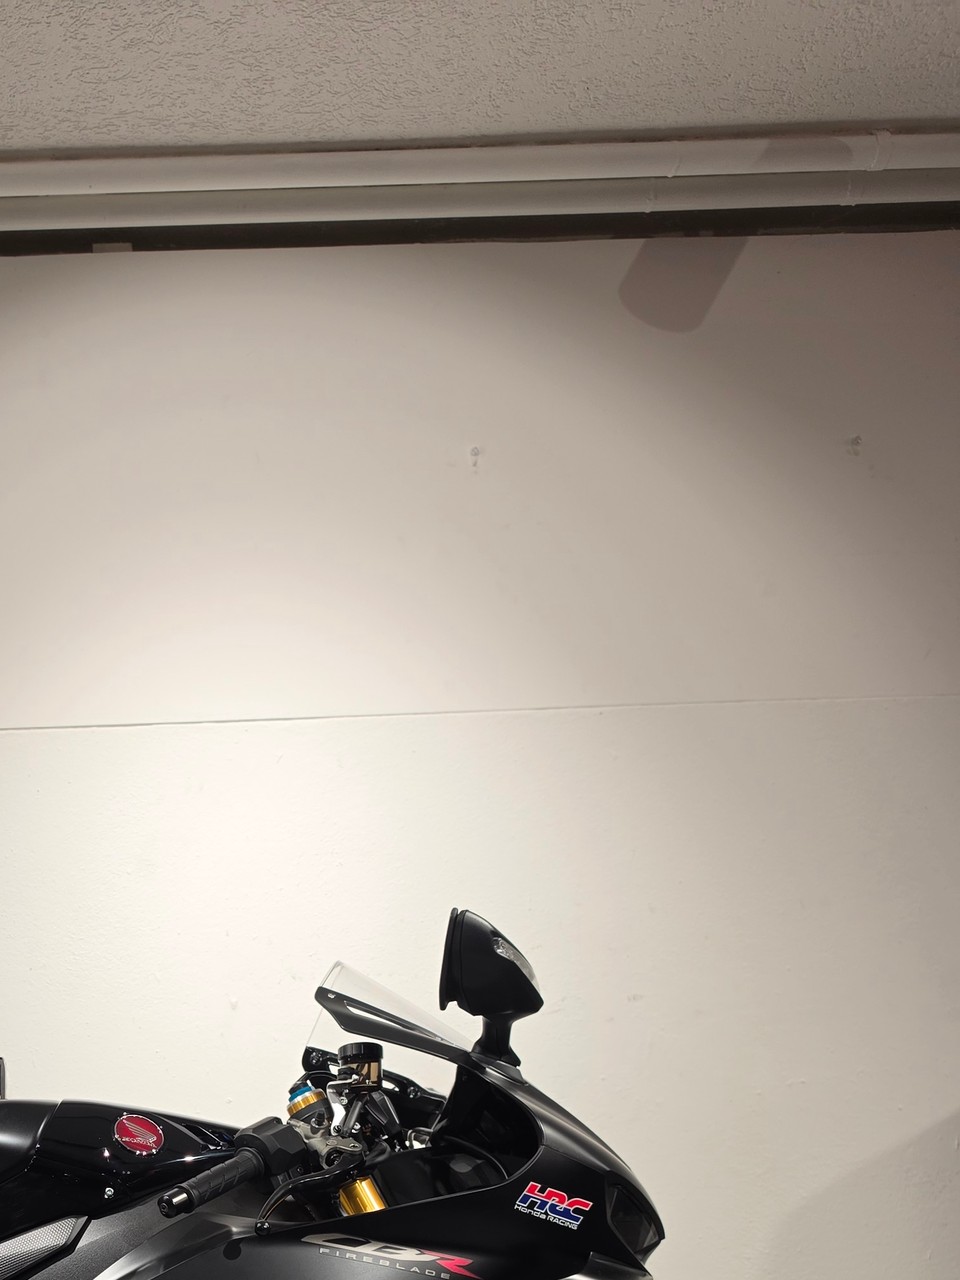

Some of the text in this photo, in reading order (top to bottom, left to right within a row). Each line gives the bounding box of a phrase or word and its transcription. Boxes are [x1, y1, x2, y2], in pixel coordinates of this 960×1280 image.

[514, 1204, 579, 1231] Honda RACING
[516, 1181, 594, 1225] HRC
[301, 1232, 485, 1280] CBR
[319, 1247, 451, 1280] FIREBLADE
